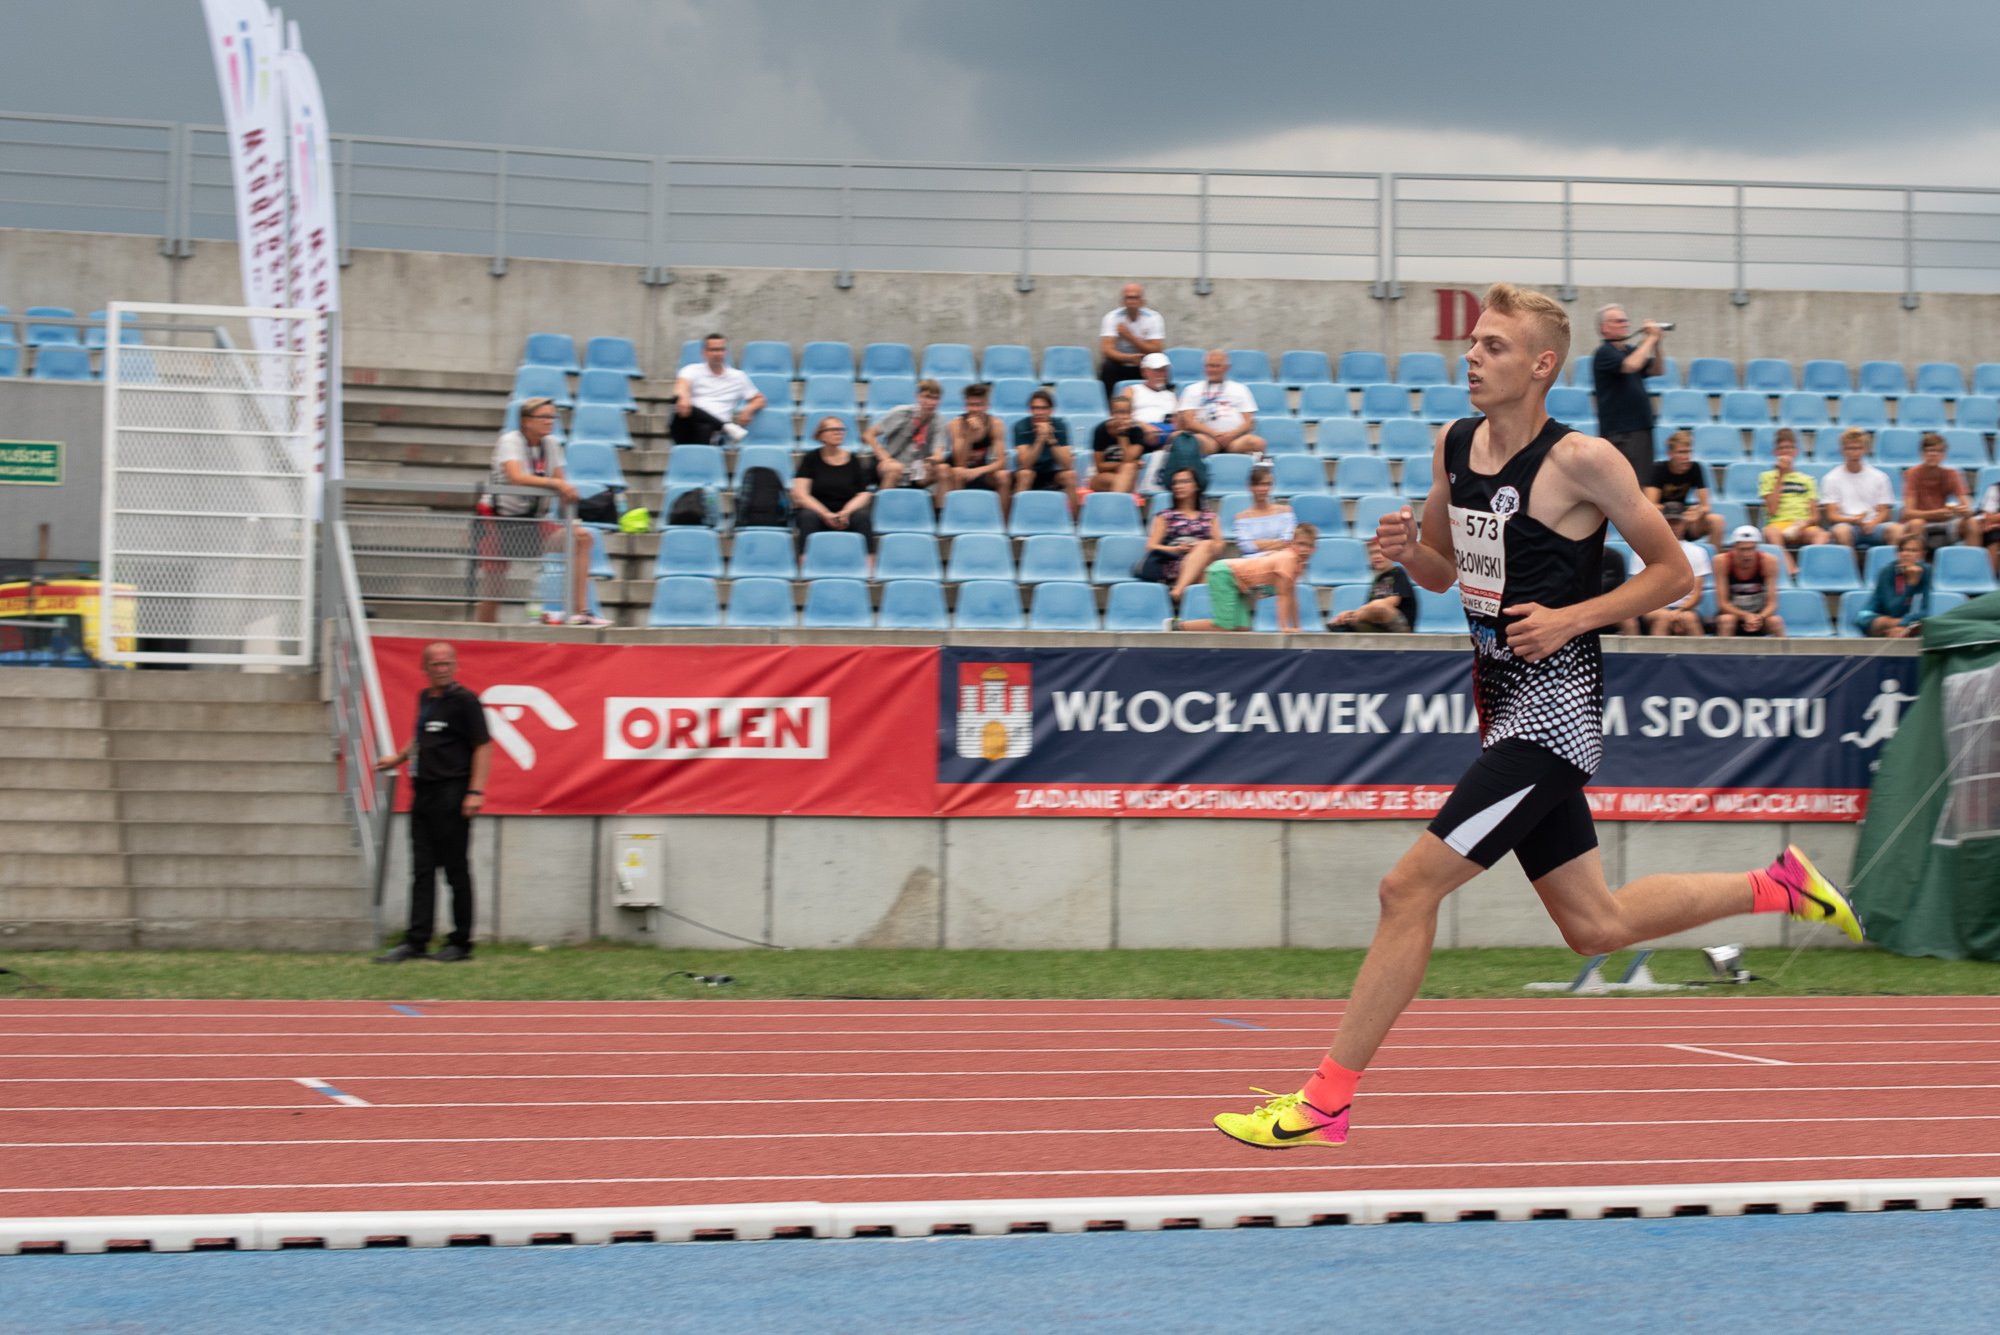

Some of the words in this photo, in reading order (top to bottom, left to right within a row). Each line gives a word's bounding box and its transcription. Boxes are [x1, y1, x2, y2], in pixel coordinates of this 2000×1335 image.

[1432, 289, 1481, 341] D
[1466, 515, 1498, 541] 573
[1454, 548, 1501, 579] OŁOWSKI
[1485, 601, 1499, 614] 202
[620, 706, 812, 750] ORLEN
[1052, 690, 1390, 734] WŁOCŁAWEK
[1640, 696, 1827, 738] SPORTU
[1015, 789, 1121, 809] ZADANIE
[1381, 790, 1410, 809] ZE
[1620, 793, 1710, 813] MIASTO
[1713, 794, 1860, 813] WŁOCŁAWEK
